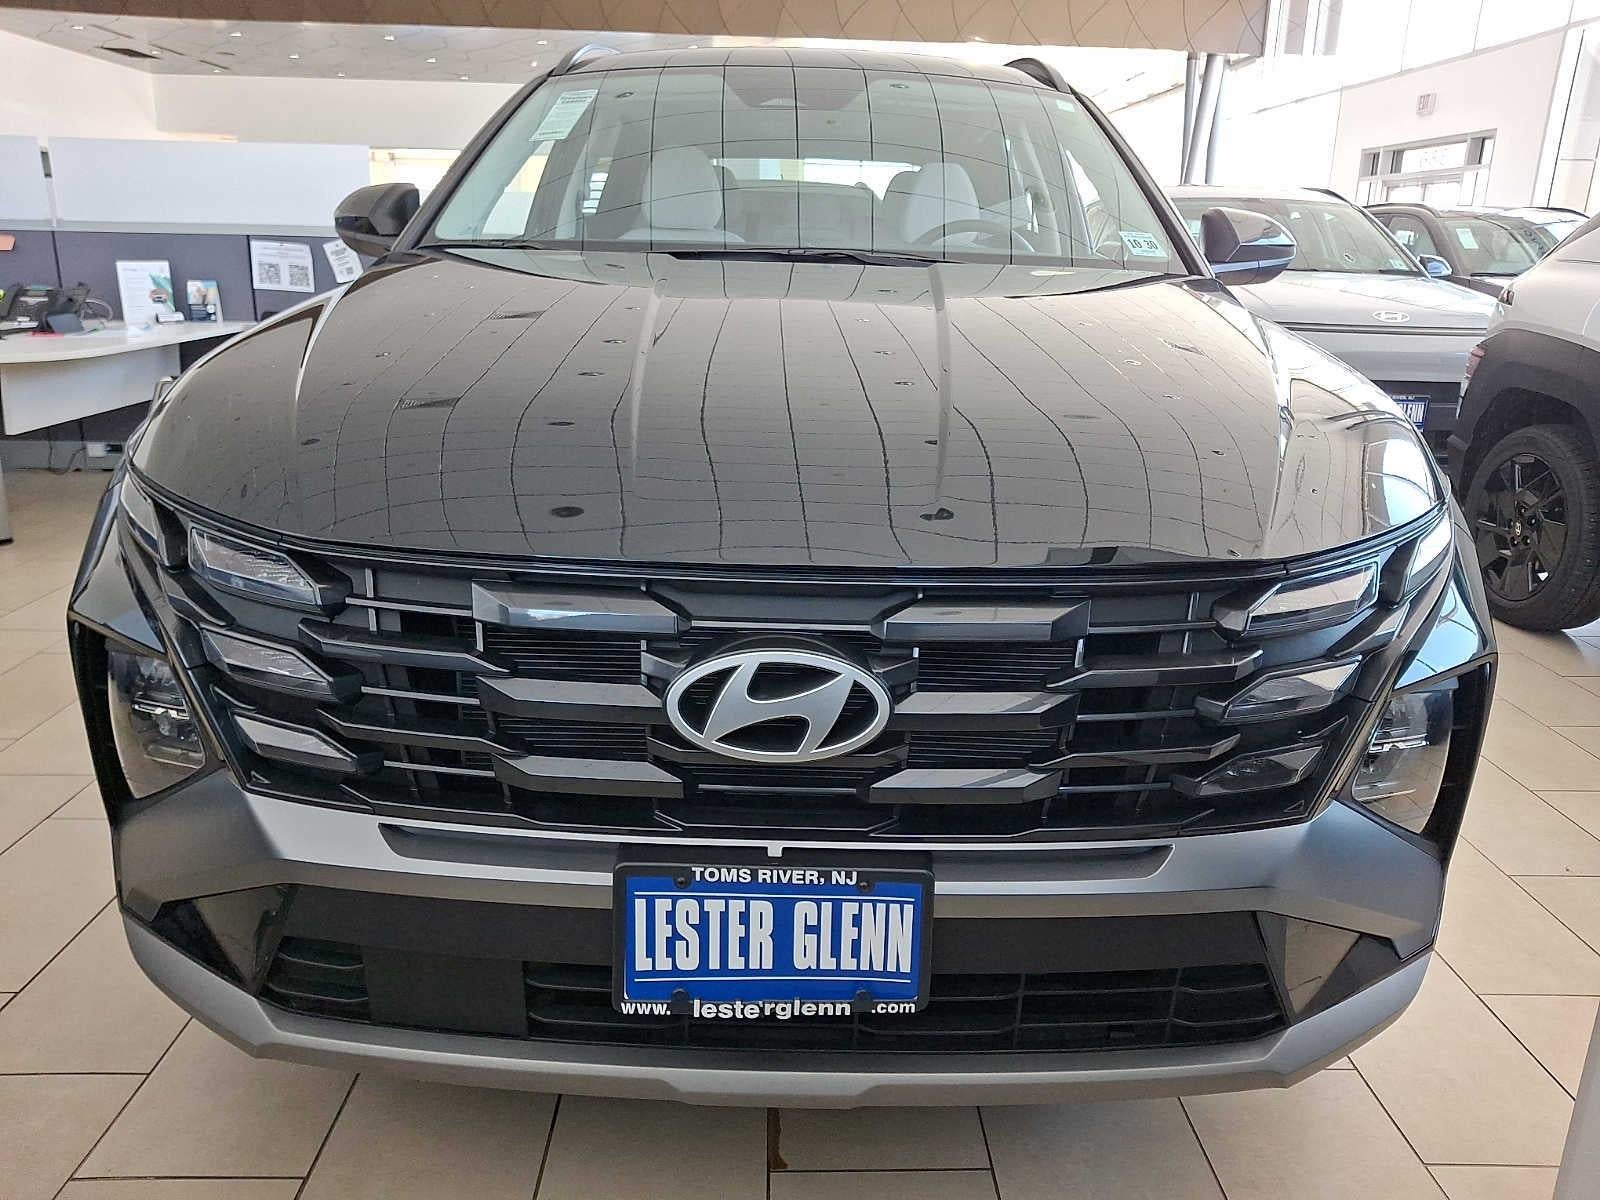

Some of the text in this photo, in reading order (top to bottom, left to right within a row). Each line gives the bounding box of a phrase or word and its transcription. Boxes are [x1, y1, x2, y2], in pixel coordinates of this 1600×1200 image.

[1127, 239, 1143, 249] 10
[692, 867, 858, 886] TOMS RIVER, NJ
[634, 898, 914, 974] LESTER GLENN
[620, 1002, 671, 1016] www.
[871, 1002, 916, 1014] .com
